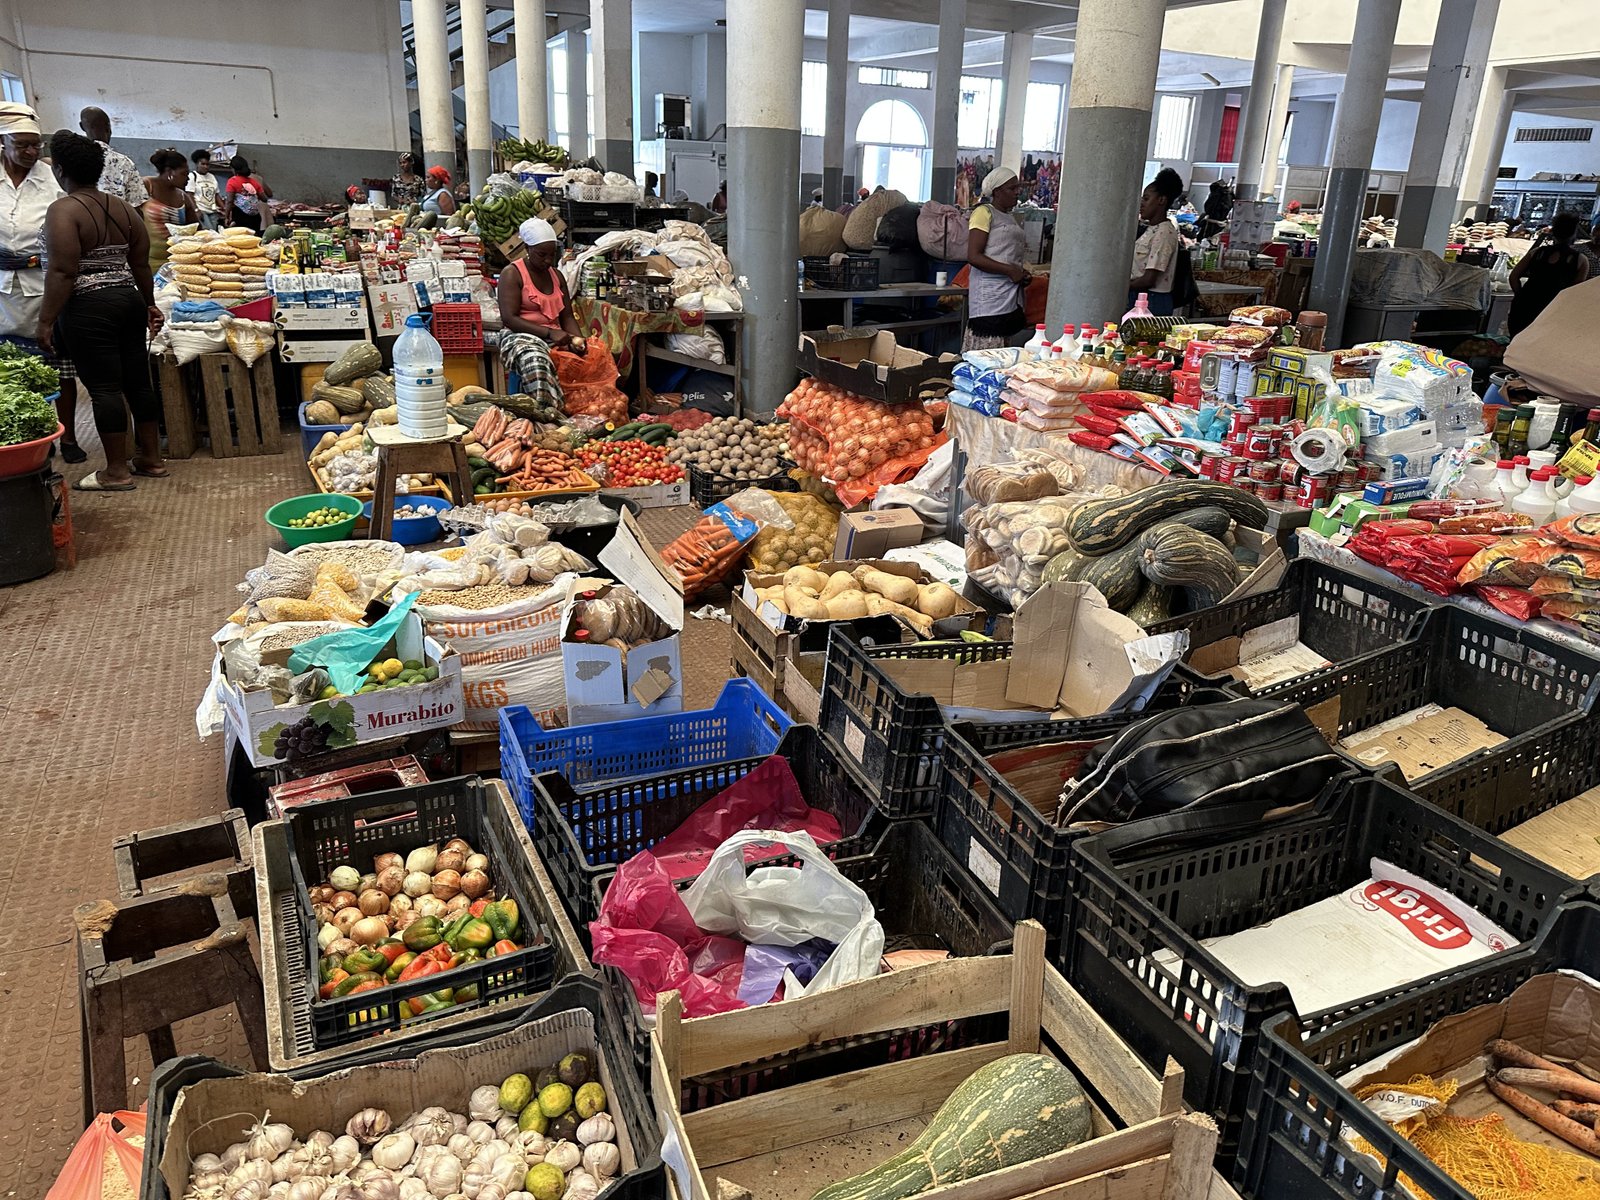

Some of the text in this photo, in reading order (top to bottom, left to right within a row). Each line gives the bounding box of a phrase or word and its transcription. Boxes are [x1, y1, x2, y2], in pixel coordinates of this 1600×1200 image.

[460, 645, 527, 666] OMMATION
[463, 679, 509, 708] KGS
[368, 703, 454, 730] Murabito
[1371, 886, 1464, 941] Frigi
[1377, 1094, 1406, 1105] V.O.F.
